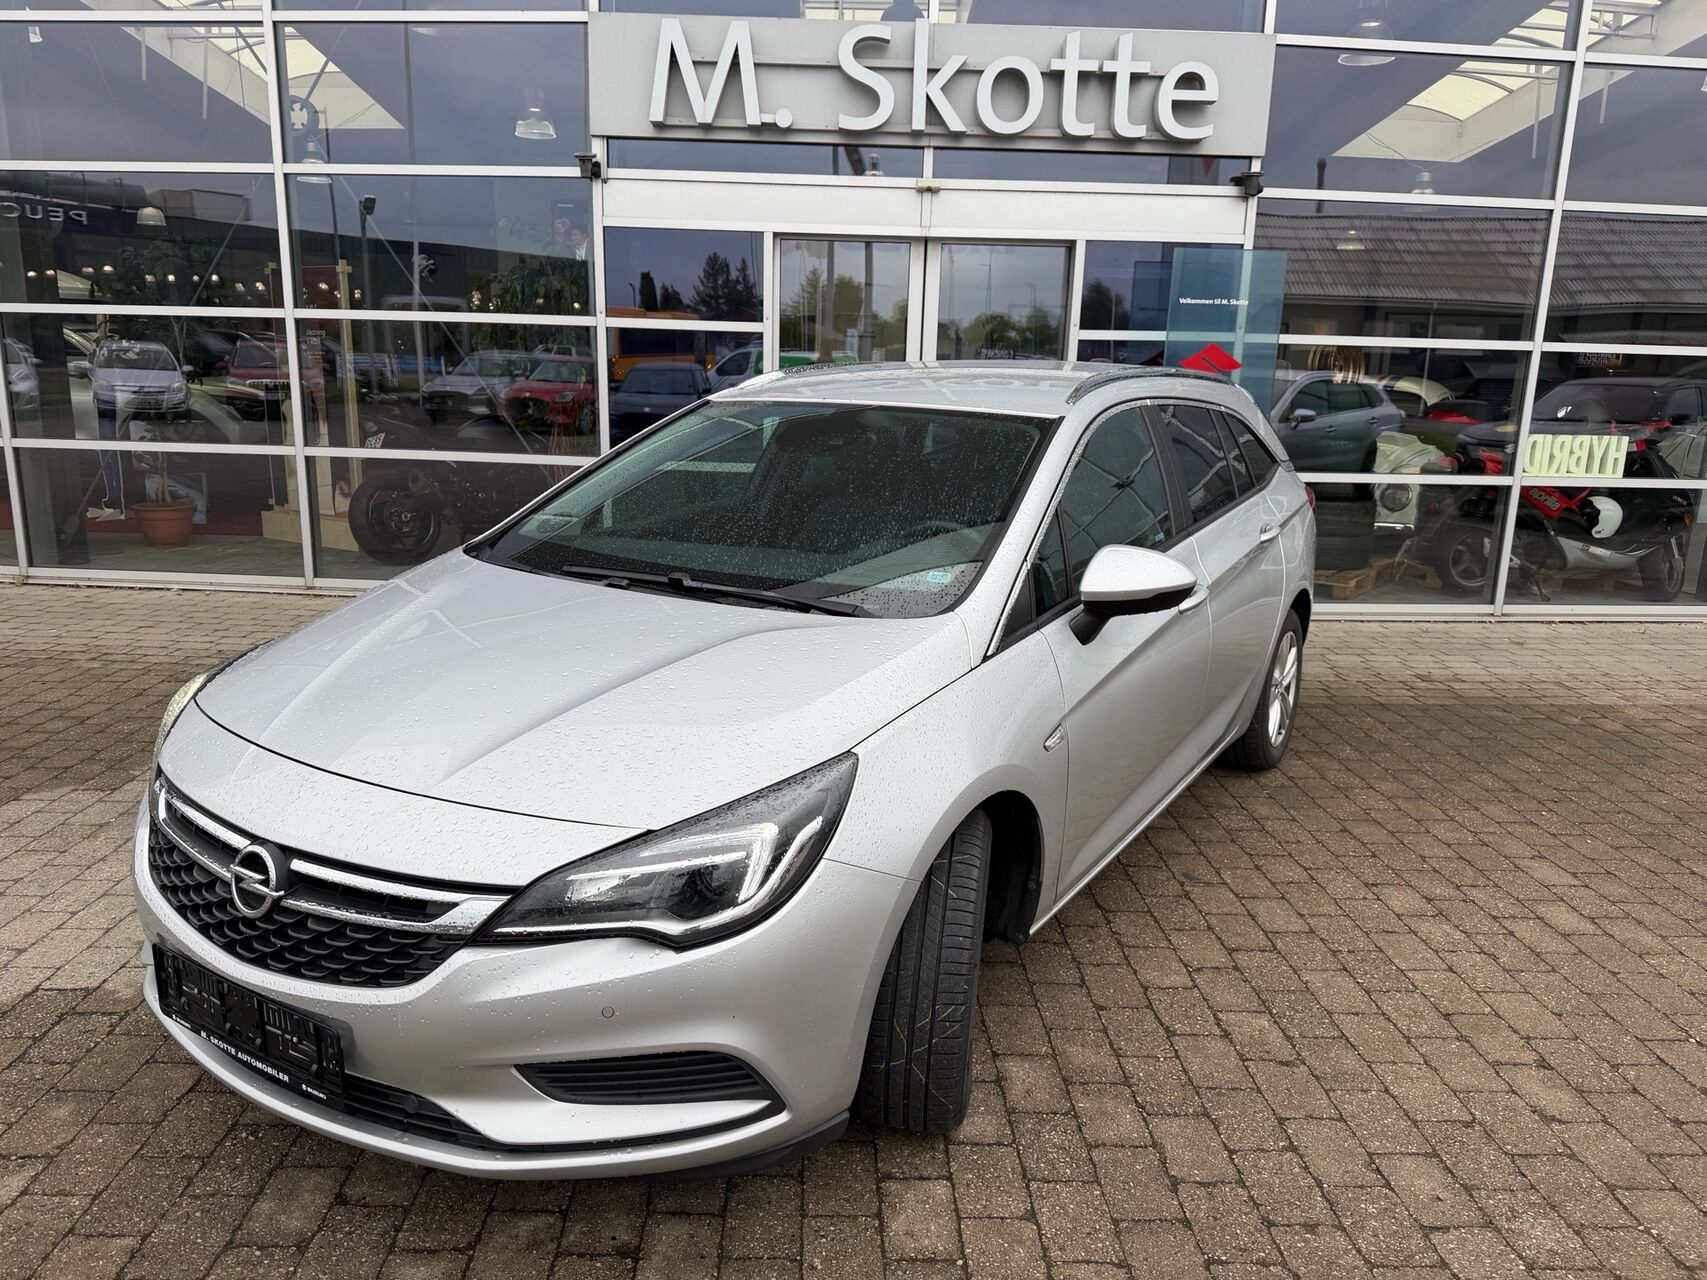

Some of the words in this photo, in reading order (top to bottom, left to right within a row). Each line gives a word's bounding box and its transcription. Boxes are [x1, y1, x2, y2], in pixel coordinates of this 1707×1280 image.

[649, 17, 794, 128] M.
[837, 17, 1220, 142] Skotte
[1178, 297, 1214, 305] Velkommen
[1230, 298, 1249, 306] Skotte
[1528, 487, 1561, 511] aprilia
[200, 1030, 209, 1040] M.
[210, 1035, 236, 1056] SKOTTE
[237, 1051, 290, 1083] AUTOMOBILER
